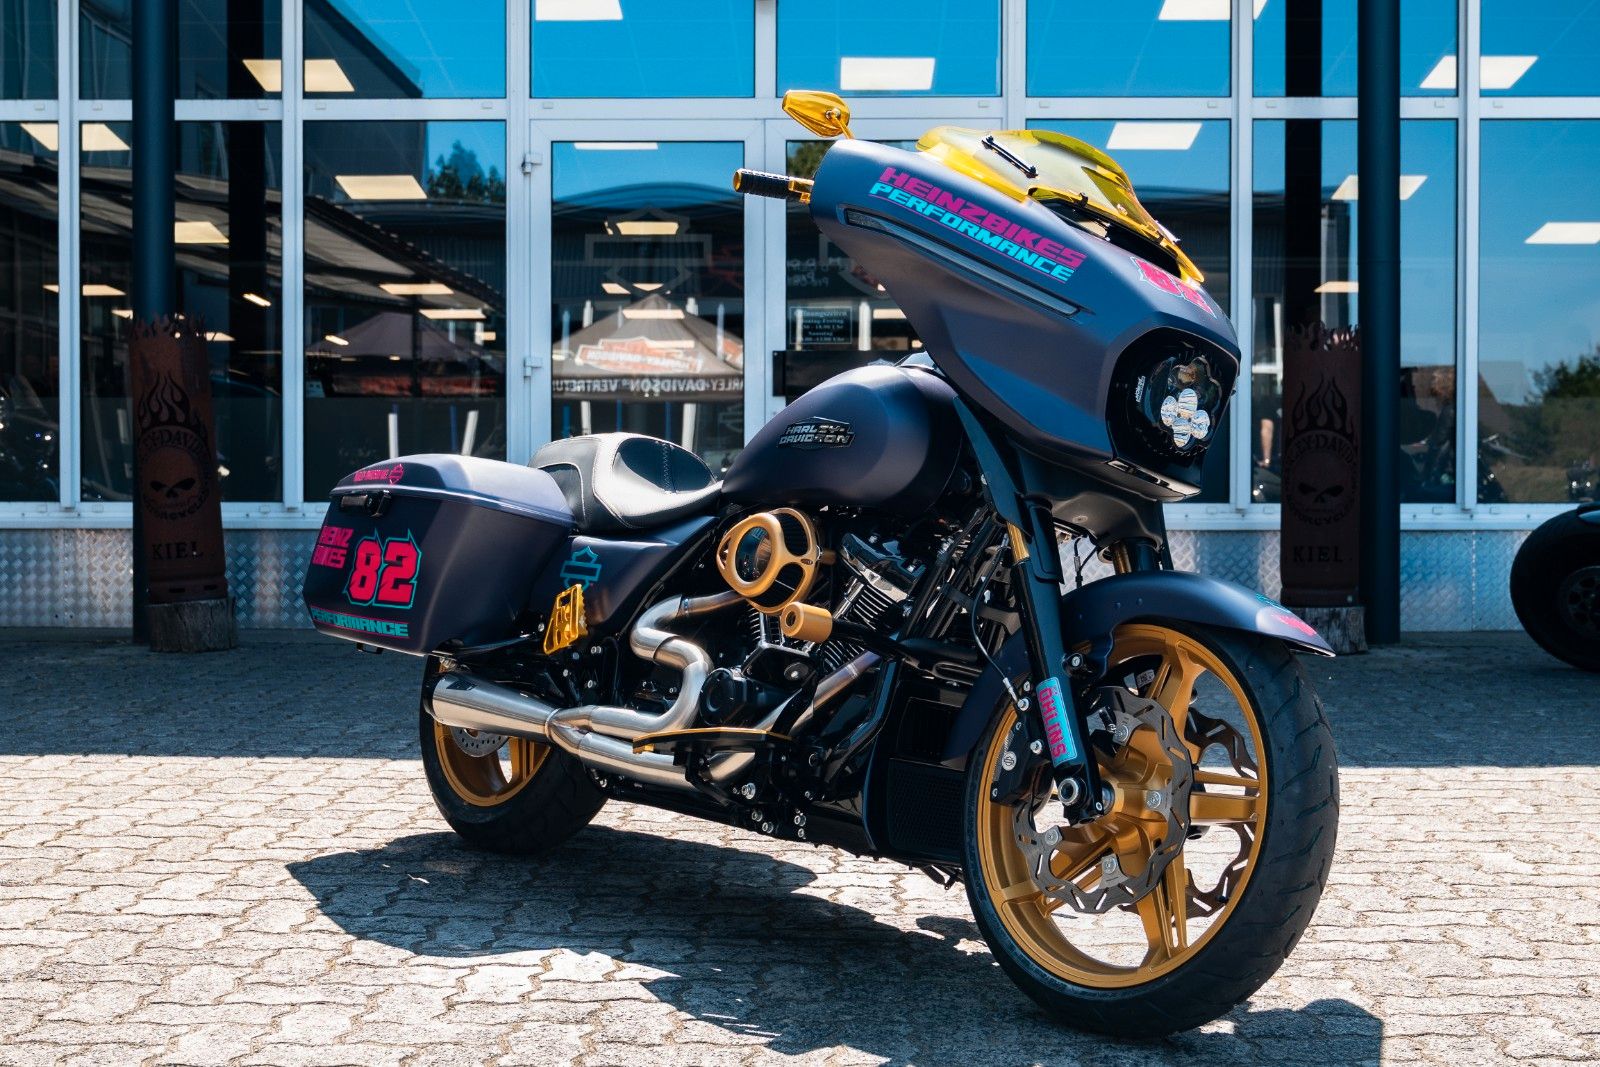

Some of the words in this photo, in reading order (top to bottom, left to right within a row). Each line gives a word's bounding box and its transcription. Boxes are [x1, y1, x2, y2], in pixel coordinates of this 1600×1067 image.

[869, 187, 1075, 283] PERFORMANCE
[879, 167, 1087, 272] HEINZBIKES
[152, 542, 203, 561] KIEL
[345, 536, 420, 607] 82
[1294, 546, 1344, 562] KIEL
